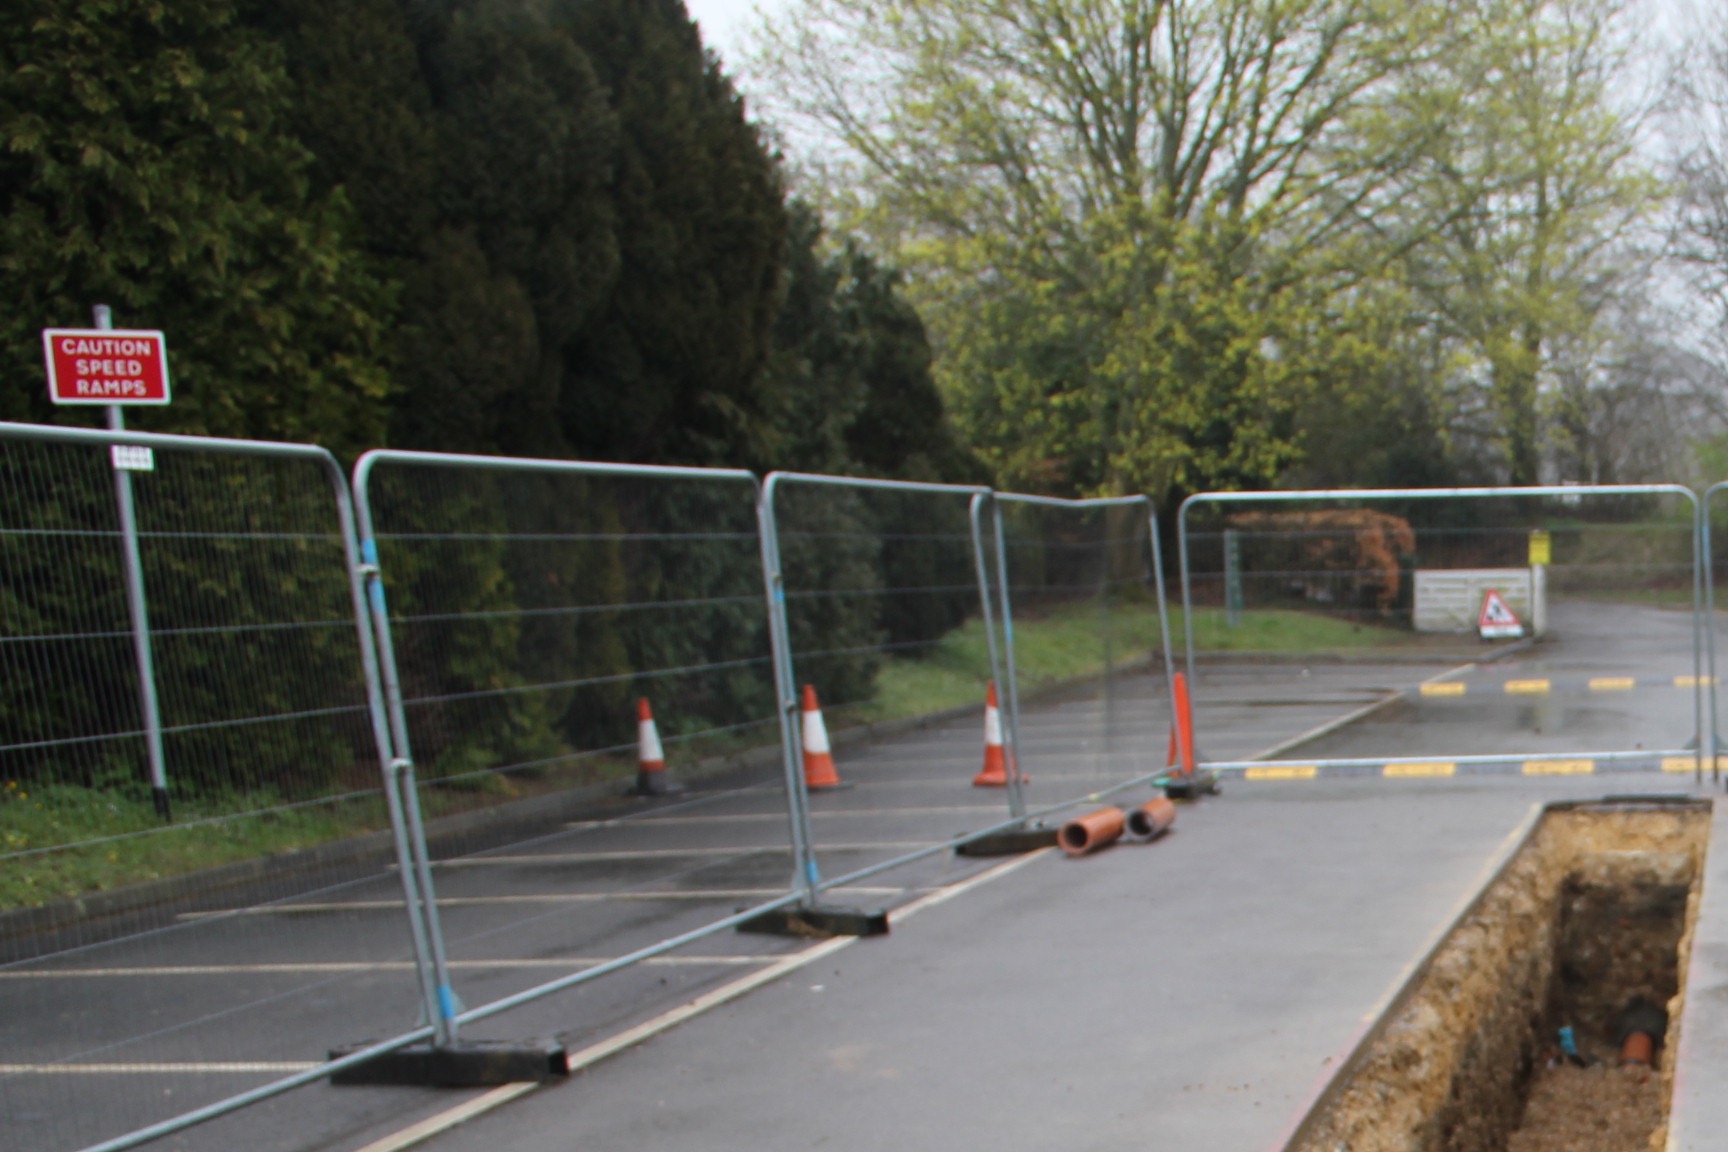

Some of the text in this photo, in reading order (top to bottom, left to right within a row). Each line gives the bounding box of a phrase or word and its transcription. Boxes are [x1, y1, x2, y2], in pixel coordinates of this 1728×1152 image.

[62, 339, 151, 356] CAUTION
[76, 359, 142, 375] SPEED
[77, 380, 146, 395] RAMPS
